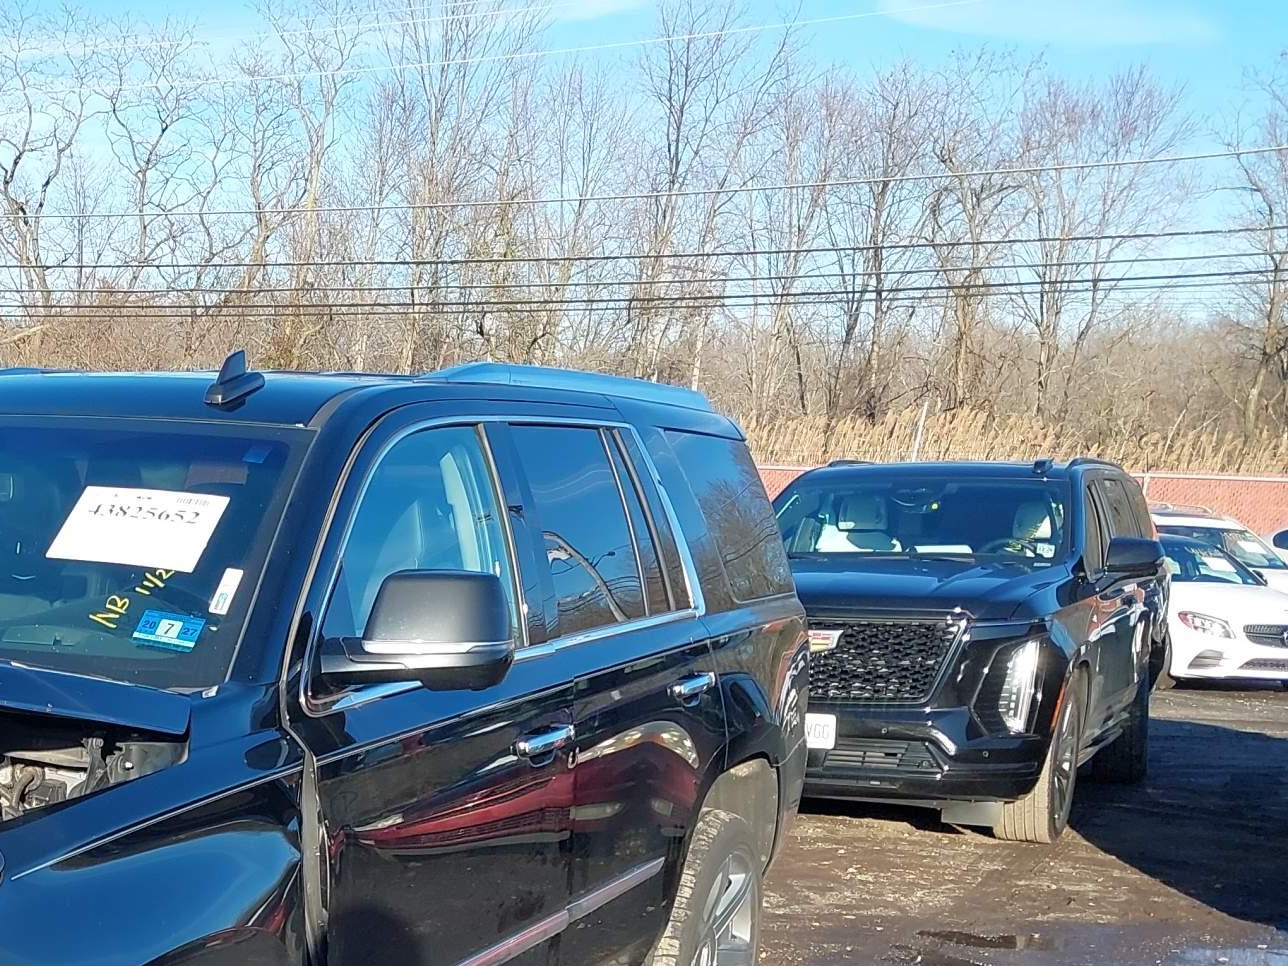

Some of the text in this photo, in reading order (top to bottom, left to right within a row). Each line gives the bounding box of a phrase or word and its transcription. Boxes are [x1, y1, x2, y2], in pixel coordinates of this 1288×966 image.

[88, 502, 200, 524] 43825652
[142, 620, 198, 636] 20 7 27
